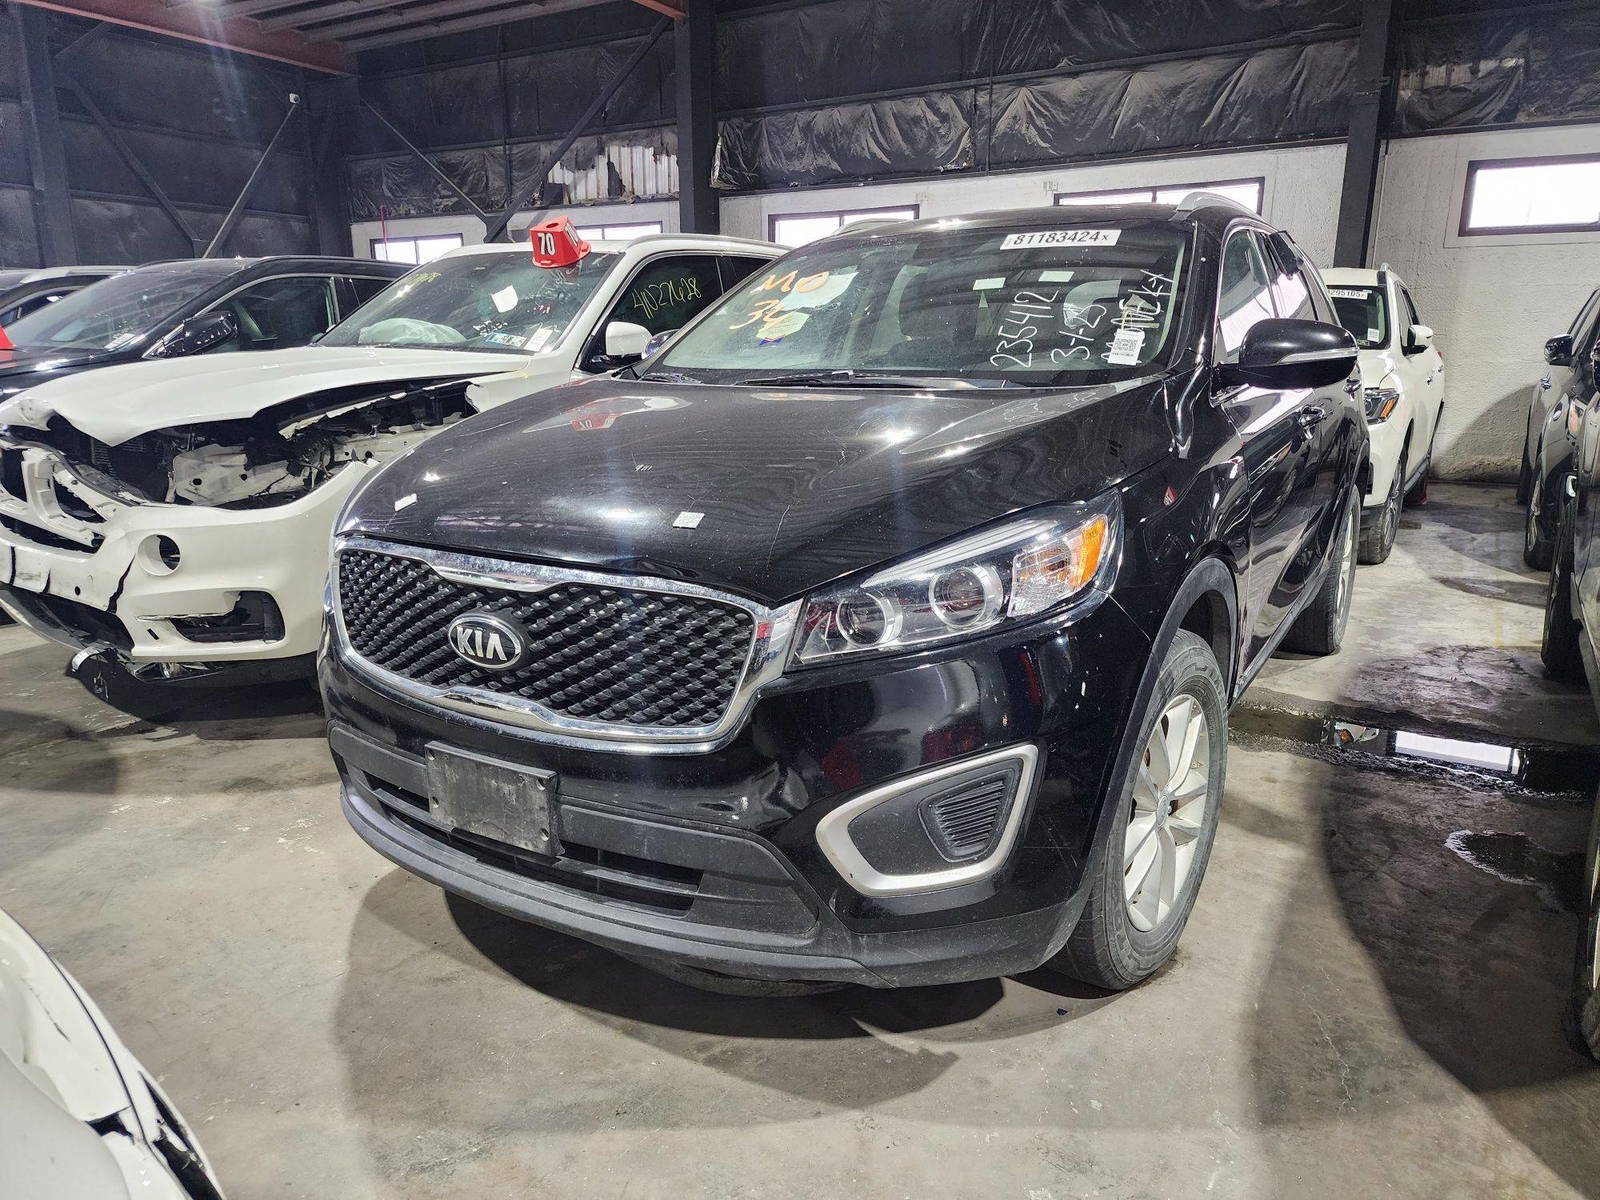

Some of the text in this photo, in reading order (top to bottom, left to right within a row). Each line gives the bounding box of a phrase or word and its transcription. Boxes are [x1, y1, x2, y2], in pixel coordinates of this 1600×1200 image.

[537, 232, 556, 256] 70
[989, 289, 1059, 368] 235412
[456, 625, 508, 661] KIA
